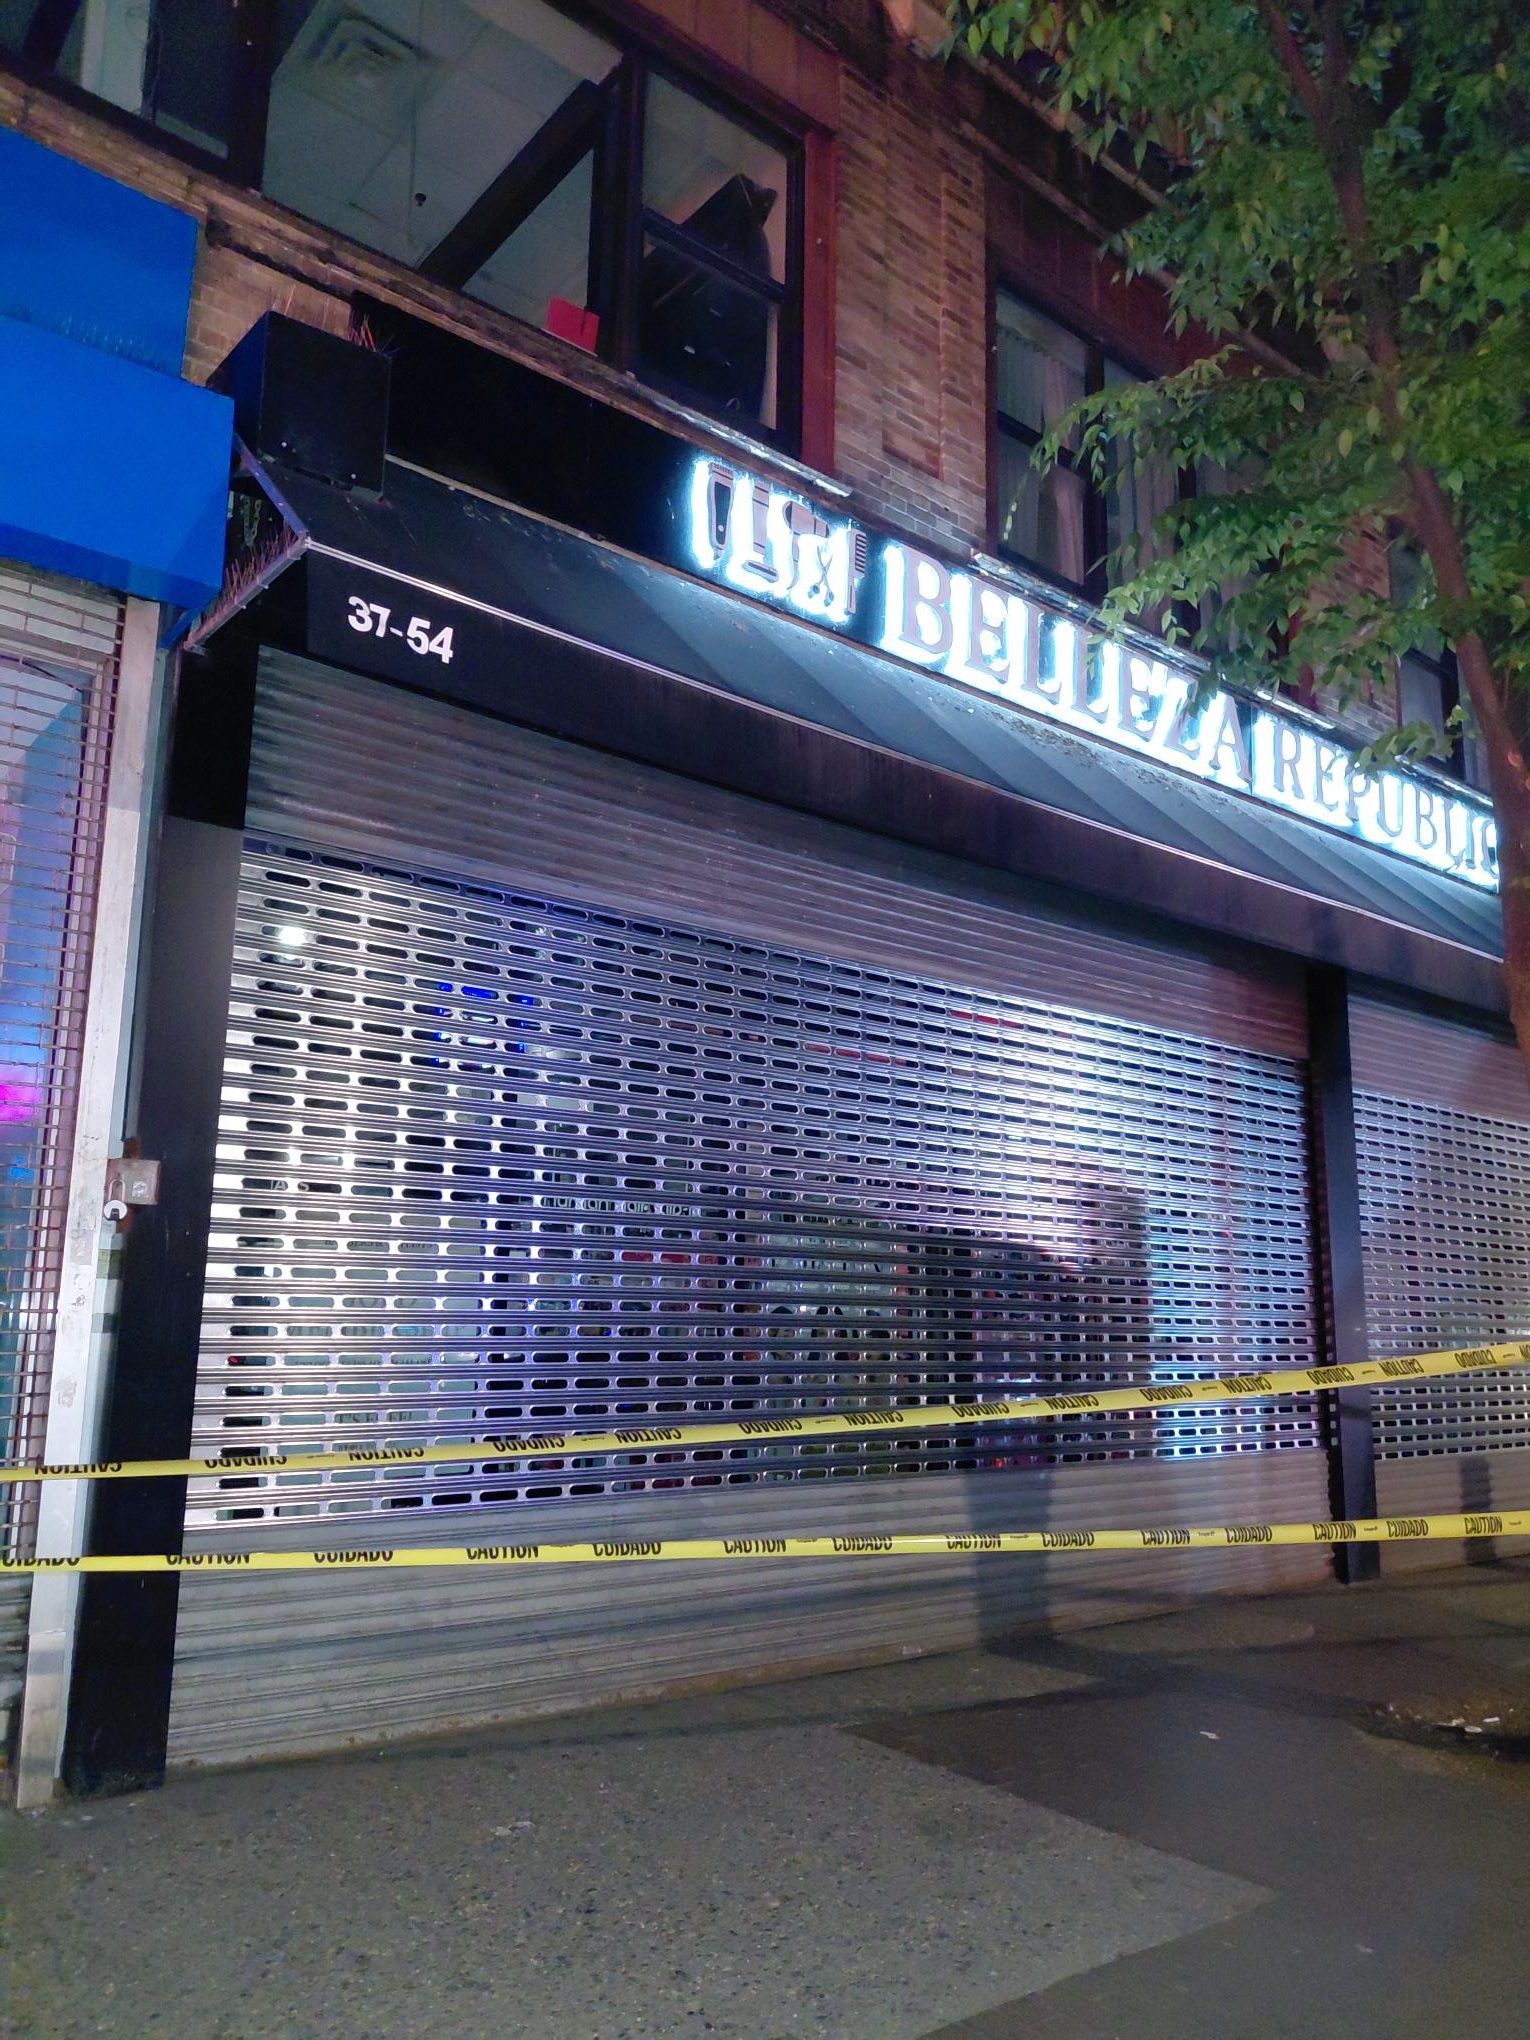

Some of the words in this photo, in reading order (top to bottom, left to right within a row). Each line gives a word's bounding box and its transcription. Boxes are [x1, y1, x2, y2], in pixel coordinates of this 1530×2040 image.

[347, 595, 455, 665] 37-54
[894, 545, 1253, 784] BELLEZA
[1378, 1358, 1425, 1377] CAUTION
[1454, 1349, 1497, 1368] CUIDADO
[1222, 1375, 1273, 1394] CAUTION
[1306, 1366, 1355, 1385] CUIDADO
[1045, 1393, 1100, 1410] CAUTION
[1140, 1384, 1193, 1401] CUIDADO
[844, 1410, 904, 1426] CAUTION
[952, 1402, 1010, 1418] CUIDADO
[739, 1417, 803, 1435] CUIDADO
[494, 1437, 565, 1452] CUIDADO
[615, 1428, 682, 1443] CAUTION
[466, 1545, 539, 1560] CAUTION
[592, 1542, 661, 1557] CUIDADO
[723, 1539, 787, 1554] CAUTION
[831, 1537, 893, 1551] CUIDADO
[946, 1535, 1001, 1550] CAUTION
[1041, 1532, 1095, 1547] CUIDADO
[1141, 1528, 1191, 1545] CAUTION
[1224, 1525, 1273, 1543] CUIDADO
[1312, 1521, 1357, 1541] CAUTION
[1386, 1519, 1429, 1538] CUIDADO
[1464, 1516, 1503, 1535] CAUTION
